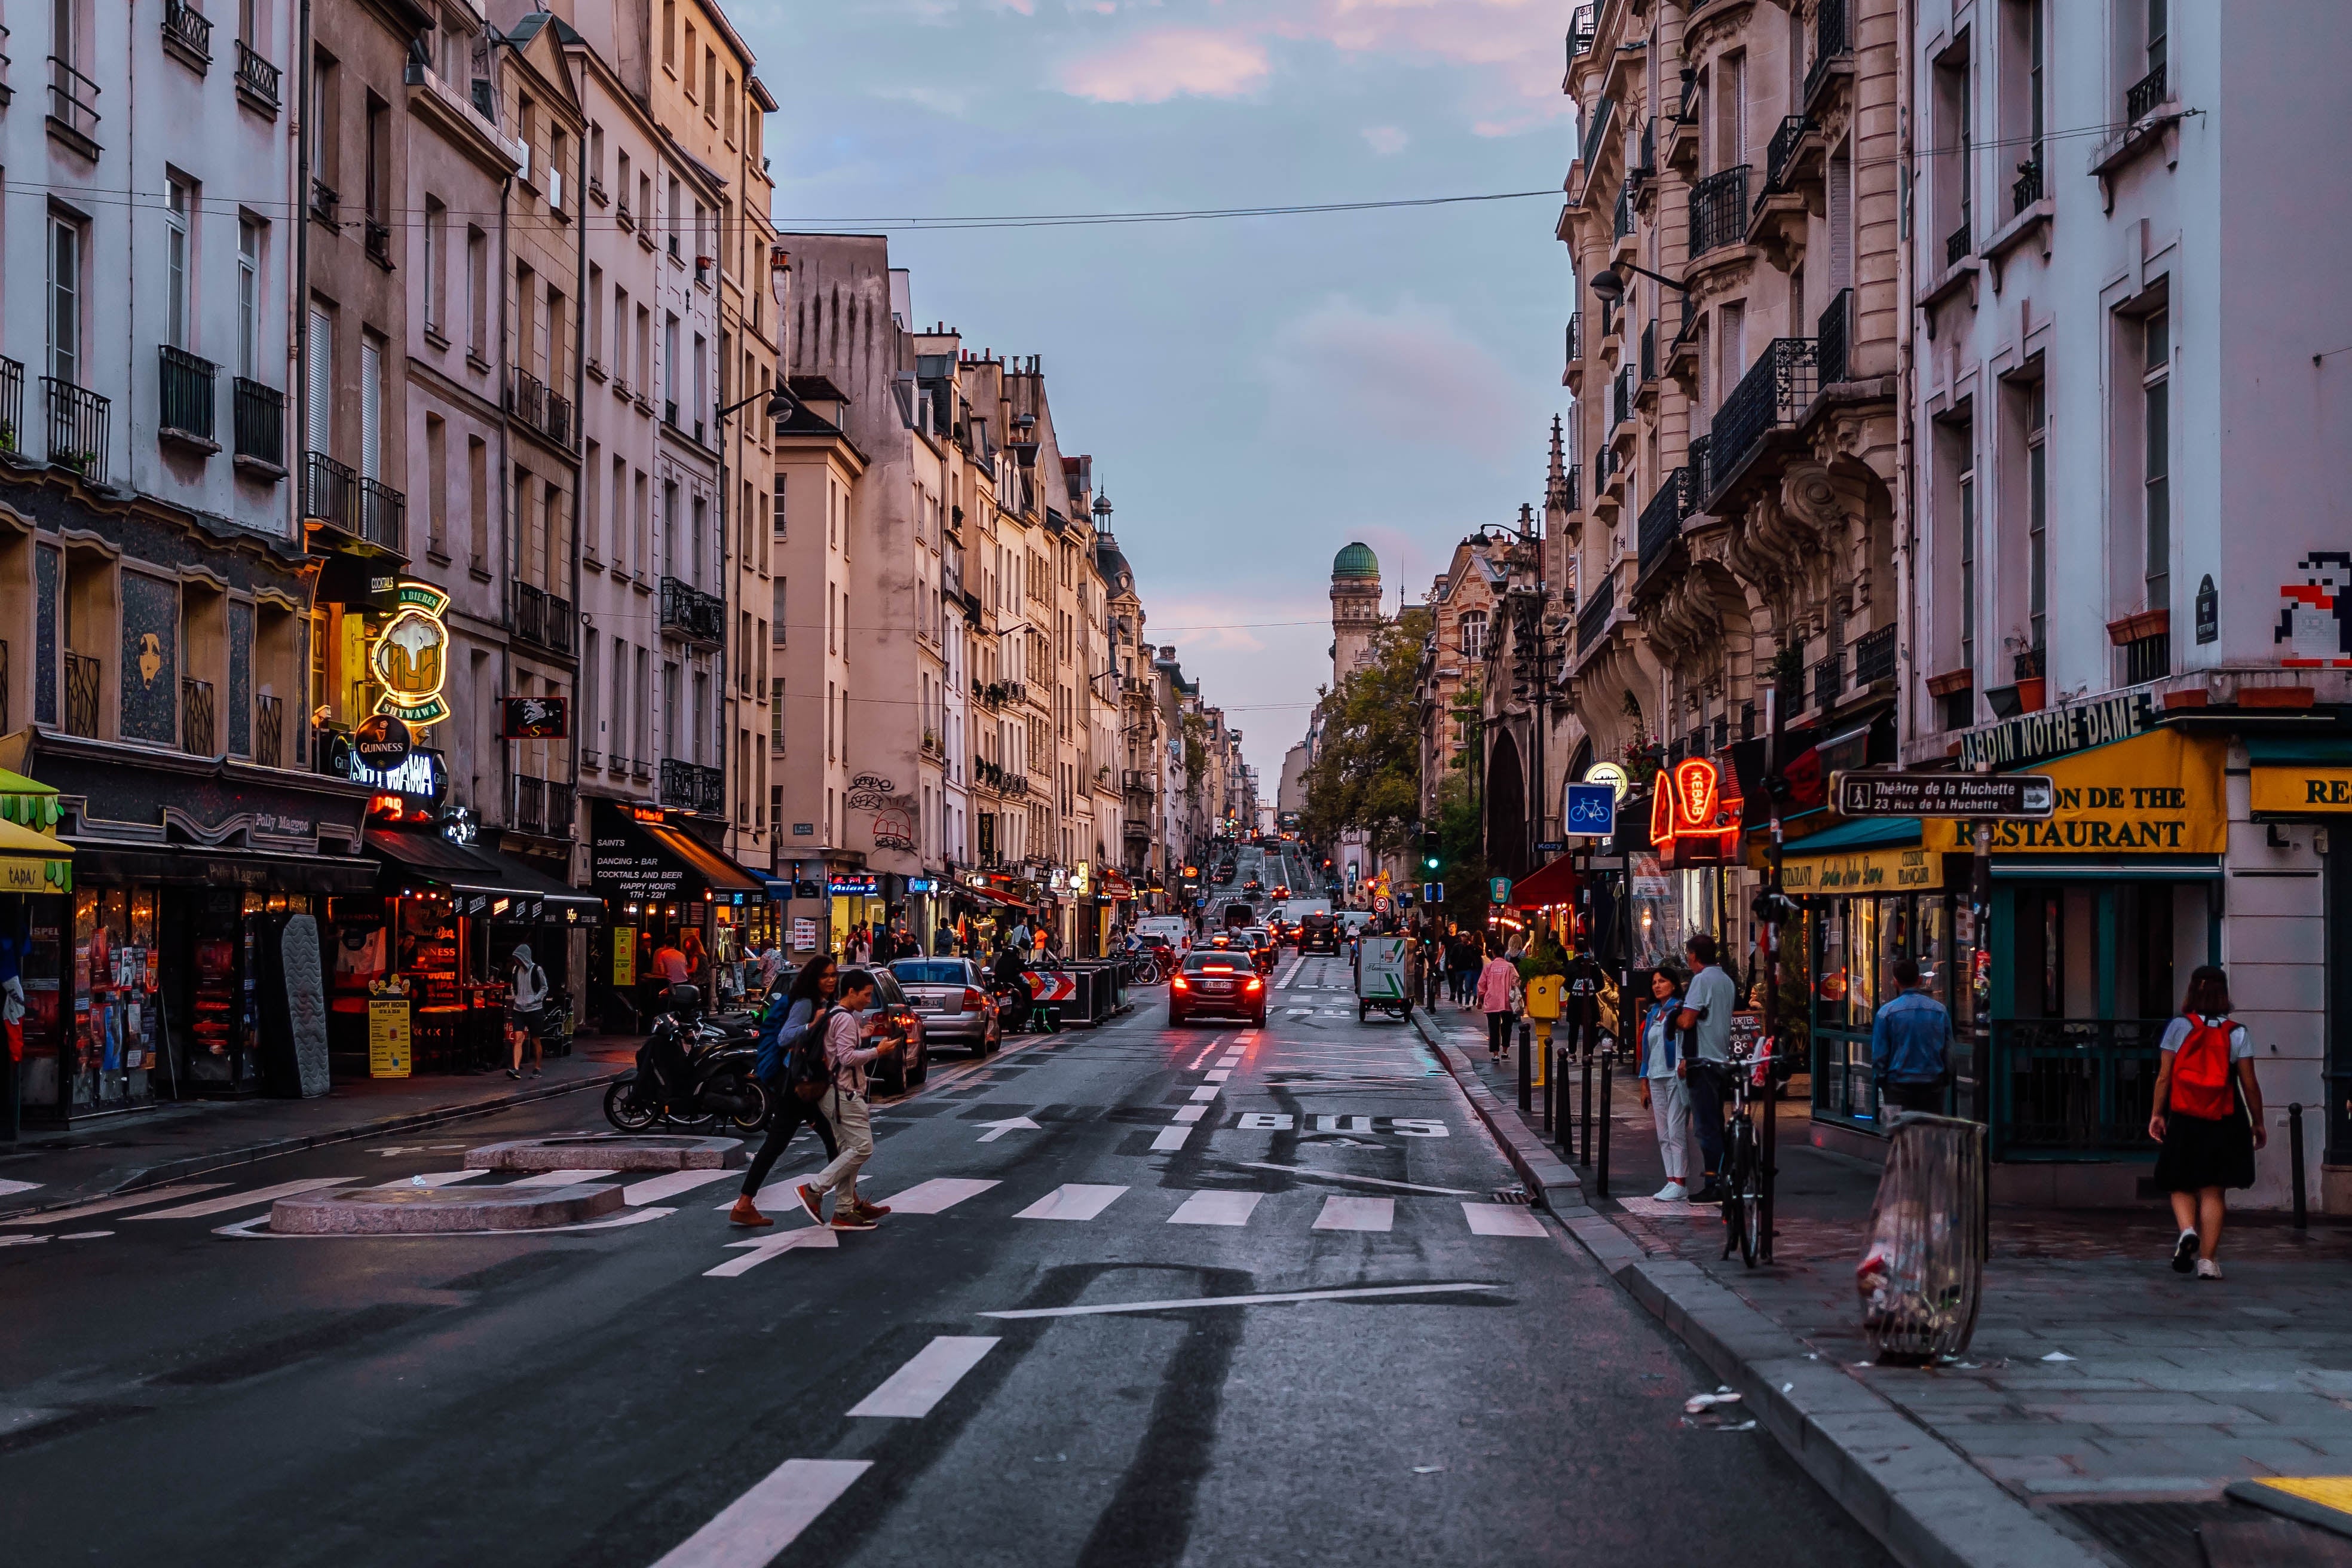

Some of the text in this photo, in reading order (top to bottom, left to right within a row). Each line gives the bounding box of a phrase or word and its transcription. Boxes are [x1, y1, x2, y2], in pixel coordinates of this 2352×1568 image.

[371, 576, 394, 589] COCKTAILS
[400, 591, 438, 608] A BIERES
[382, 703, 439, 718] SHYWAWA
[360, 743, 403, 753] GUINNESS
[1959, 722, 2014, 771] JARDIN
[1691, 771, 1704, 816] KEBAB
[1875, 782, 2016, 795] Théâtre de la Huchette
[2305, 780, 2352, 804] RE
[1894, 800, 1915, 810] Rue
[1919, 799, 1932, 810] de
[1936, 799, 1946, 810] la
[1950, 799, 1998, 810] Huchette
[2088, 788, 2124, 808] DE
[2130, 788, 2186, 808] THE
[256, 813, 308, 834] Polly Maggoo
[1954, 820, 2186, 847] RESTAURANT
[434, 926, 455, 939] Beer
[1731, 1016, 1756, 1025] PORTER
[1237, 1113, 1450, 1137] BUS
